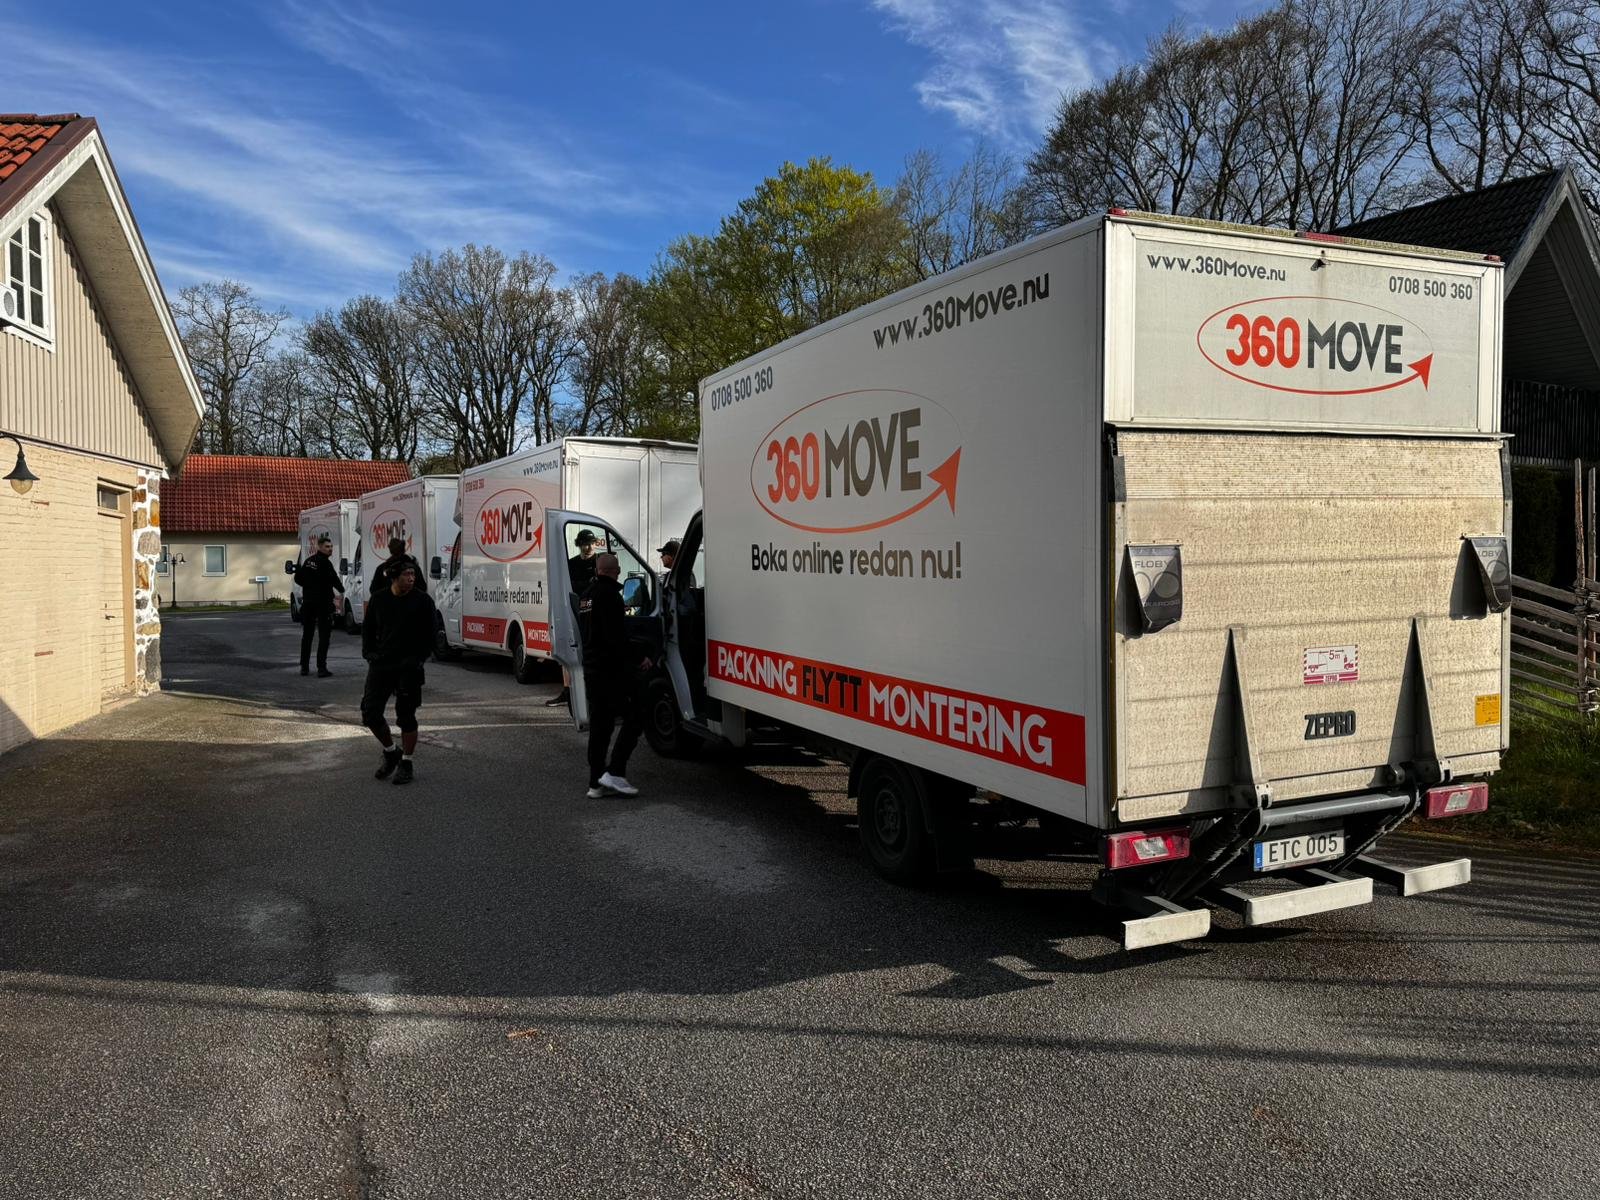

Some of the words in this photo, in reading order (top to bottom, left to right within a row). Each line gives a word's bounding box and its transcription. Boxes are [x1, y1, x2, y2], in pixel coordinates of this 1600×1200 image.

[1147, 254, 1286, 282] www.360Move.nu
[1389, 276, 1419, 295] 0708
[1424, 280, 1446, 298] 500
[1451, 283, 1472, 300] 360
[873, 272, 1050, 350] www.360Move.nu
[1226, 313, 1300, 369] 360
[1307, 317, 1403, 373] MOVE
[711, 383, 732, 411] 0708
[734, 375, 752, 402] 500
[754, 365, 773, 394] 360
[767, 432, 820, 504] 360
[824, 407, 922, 498] MOVE
[481, 507, 500, 545] 360
[501, 501, 532, 544] MOVE
[751, 543, 788, 572] Boka
[793, 542, 843, 575] online
[850, 541, 913, 577] redan
[921, 541, 962, 579] nu!
[1135, 560, 1169, 569] FLOBY
[474, 587, 488, 602] Boka
[489, 587, 508, 603] online
[510, 587, 529, 604] redan
[717, 645, 797, 695] PACKNING
[802, 665, 862, 712] FLYTT
[869, 679, 1053, 767] MONTERING
[1304, 710, 1356, 740] ZEPRO
[1269, 840, 1301, 863] ETC
[1306, 833, 1338, 856] 005
